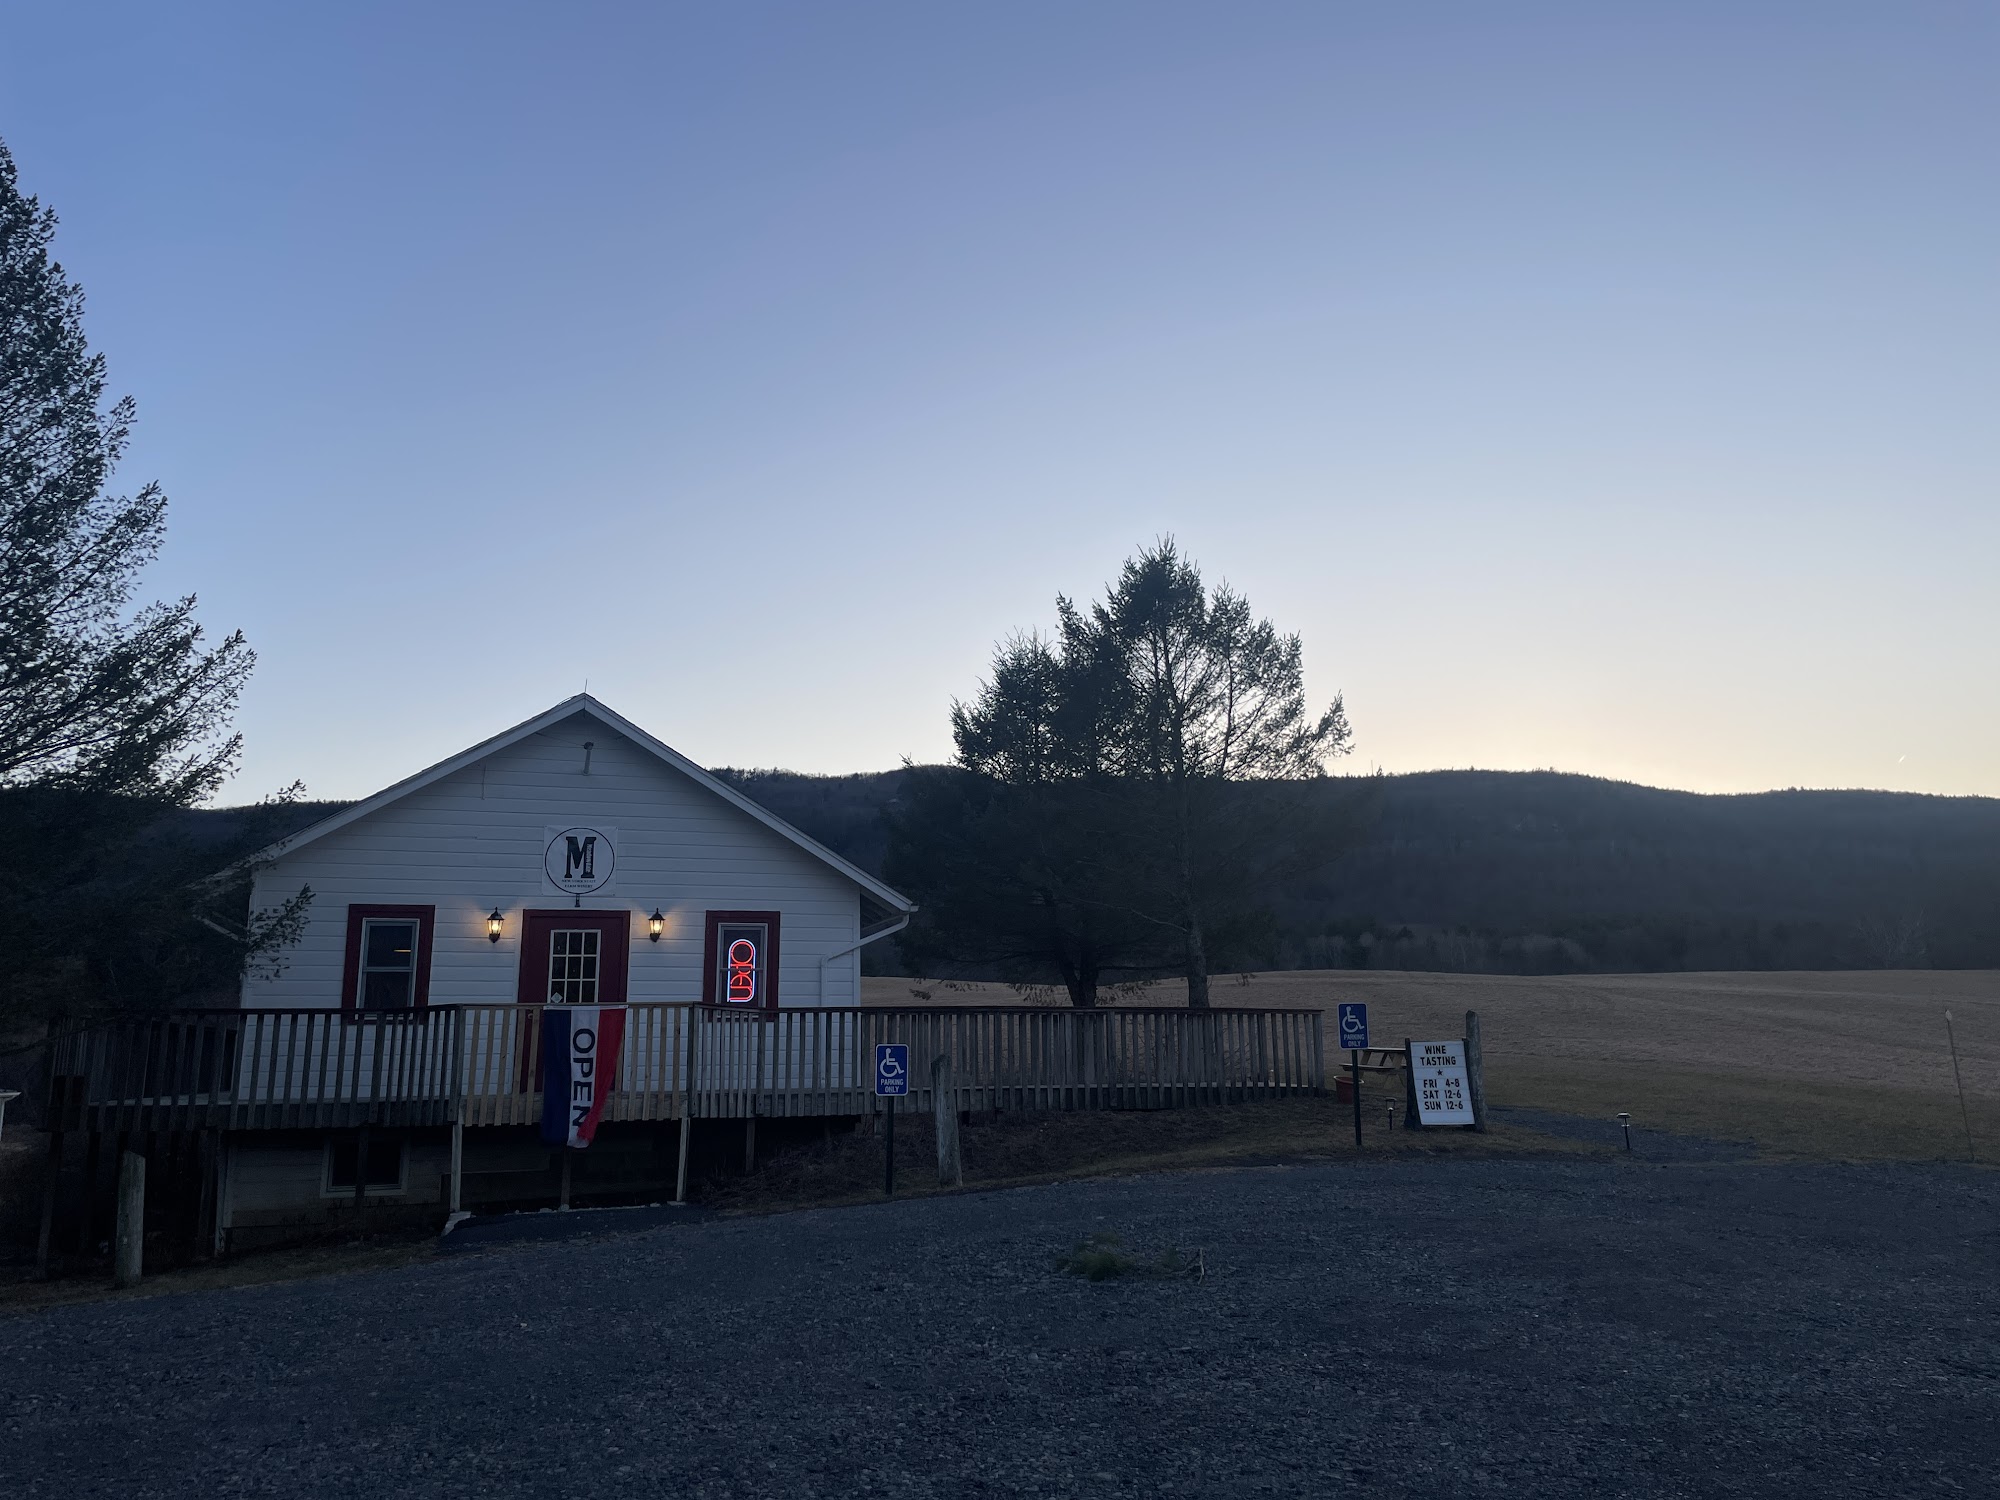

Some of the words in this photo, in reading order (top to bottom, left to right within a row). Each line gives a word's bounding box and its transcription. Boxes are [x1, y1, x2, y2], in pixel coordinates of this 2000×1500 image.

[564, 836, 597, 878] M
[1424, 1045, 1446, 1054] WINE
[1420, 1056, 1456, 1066] TASTING
[572, 1028, 596, 1127] OPEN
[880, 1078, 904, 1086] PARKING
[1423, 1079, 1437, 1088] FRI
[1445, 1078, 1460, 1088] 4-8
[1423, 1090, 1439, 1099] SAT
[1444, 1089, 1462, 1099] 12-6
[1424, 1101, 1441, 1110] SUN
[1445, 1101, 1464, 1110] 12-6
